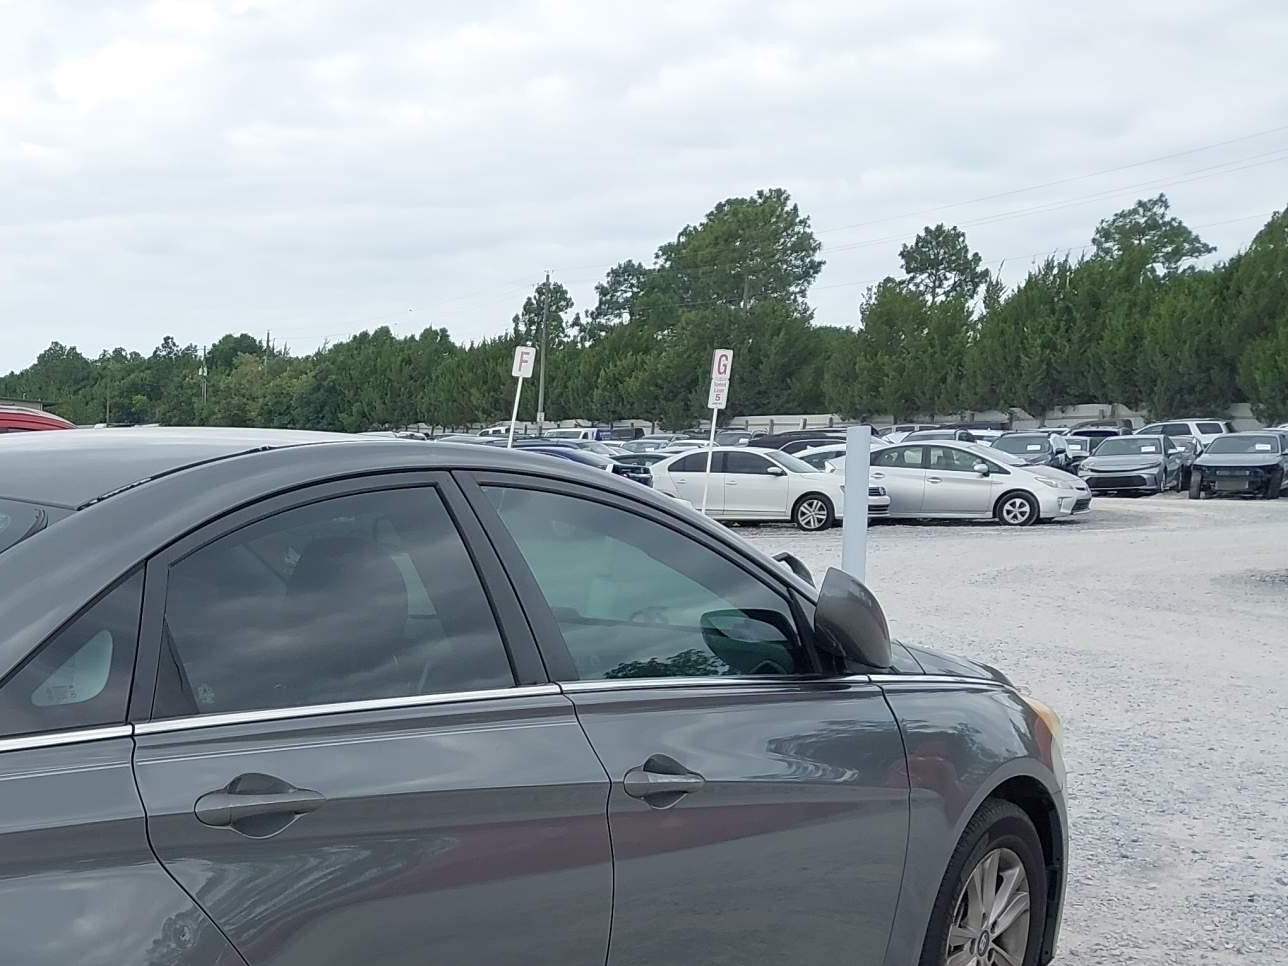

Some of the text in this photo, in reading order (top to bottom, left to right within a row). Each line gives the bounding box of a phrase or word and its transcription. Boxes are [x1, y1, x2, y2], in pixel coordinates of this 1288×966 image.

[518, 351, 531, 372] F
[717, 353, 729, 375] G
[714, 393, 721, 402] 5
